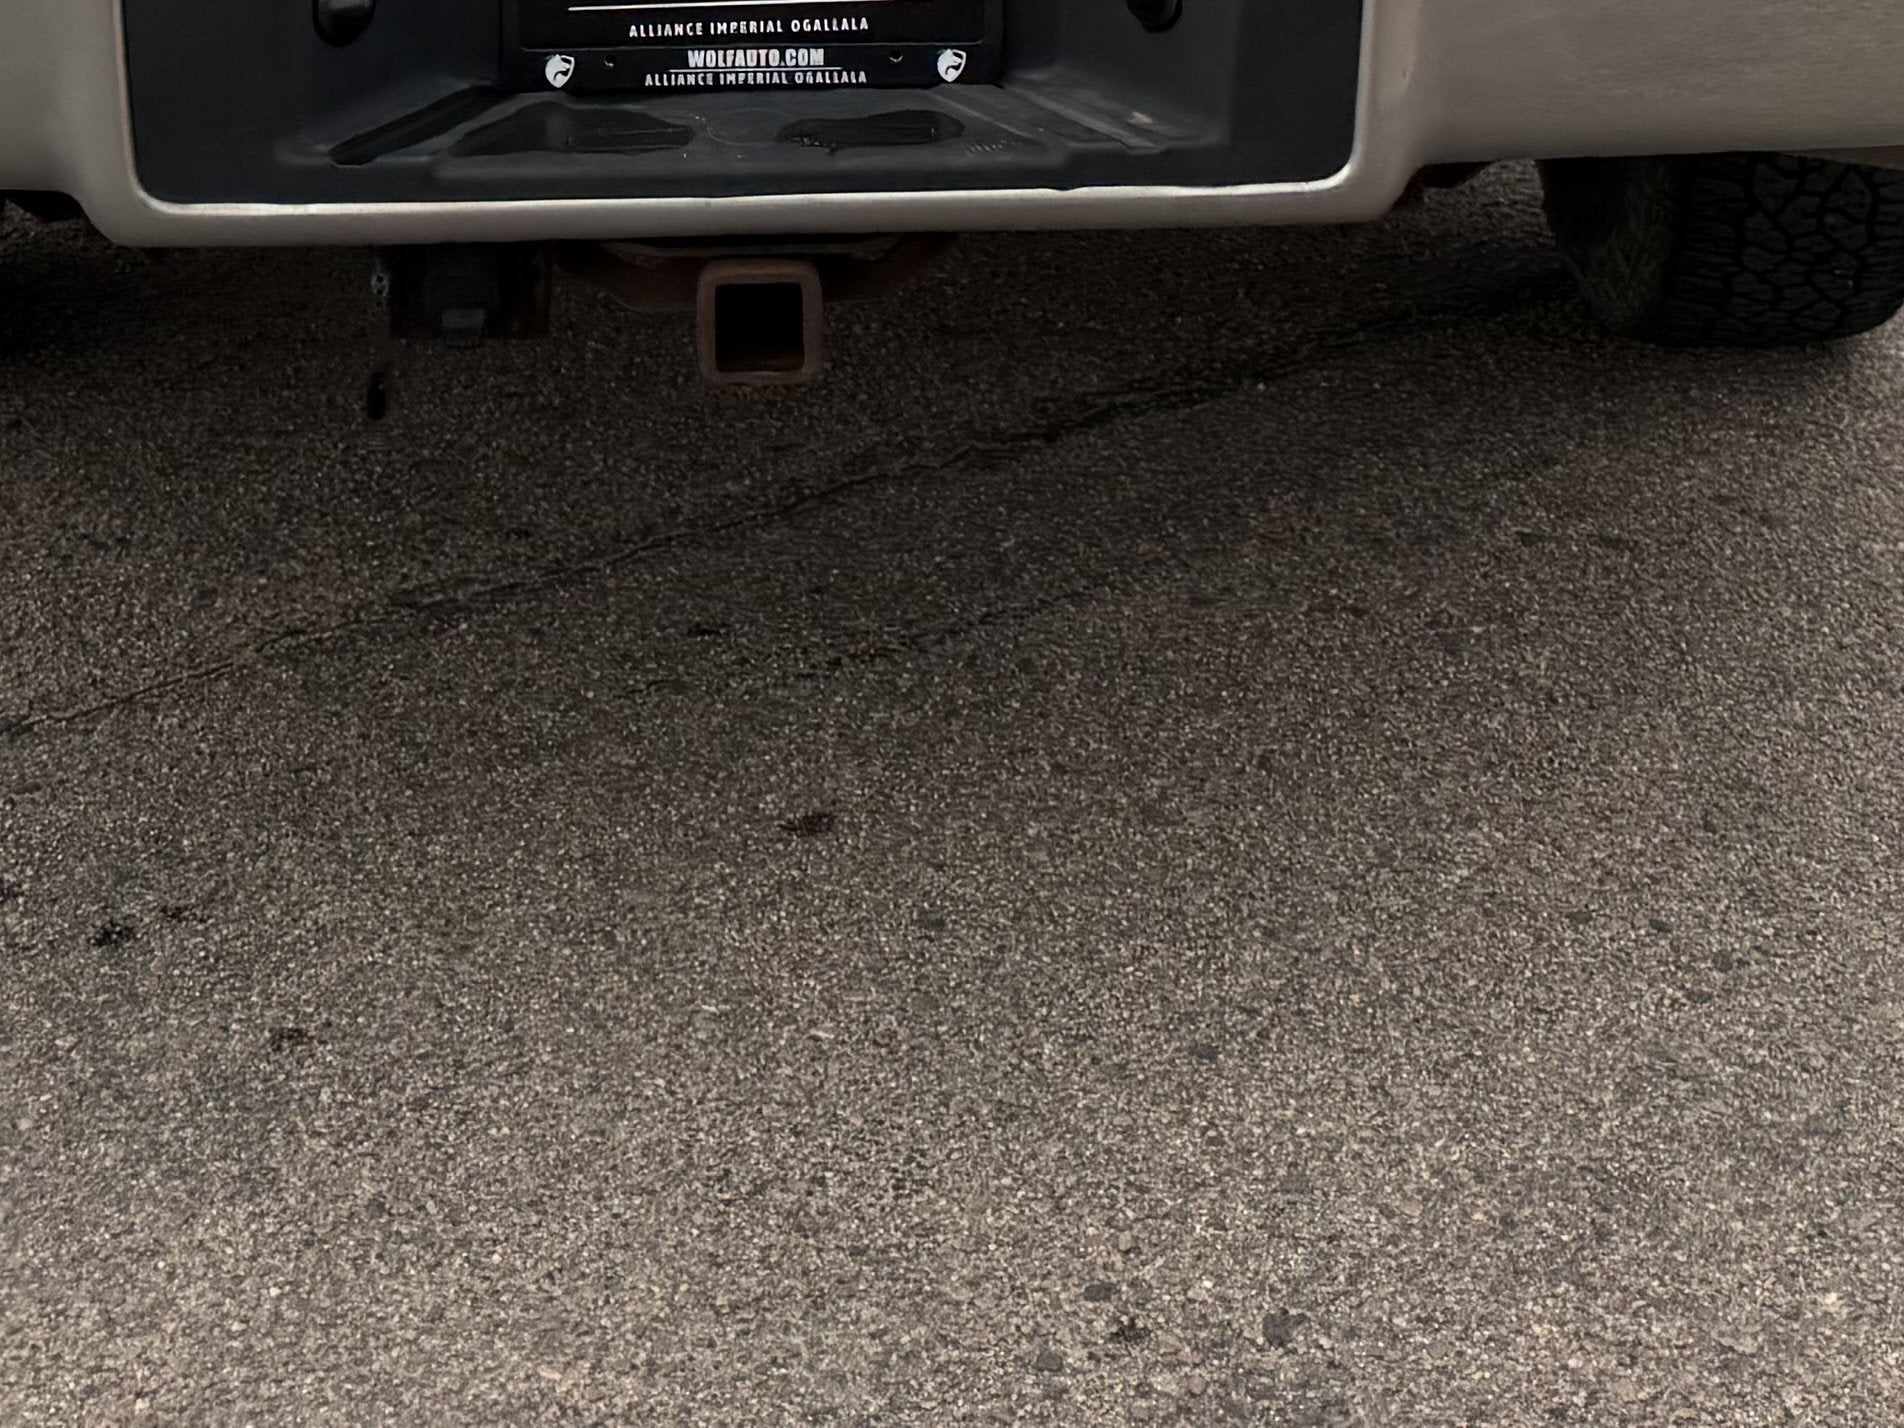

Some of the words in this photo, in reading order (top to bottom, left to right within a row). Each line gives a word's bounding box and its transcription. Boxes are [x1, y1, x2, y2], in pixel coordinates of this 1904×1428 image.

[629, 21, 704, 38] ALLIANCE
[709, 19, 784, 36] IMPERIAL
[790, 16, 870, 33] OGALLALA
[687, 47, 825, 68] WOLFAUTO.COM
[644, 72, 714, 87] ALLIANCE
[719, 71, 789, 85] IMPERIAL
[794, 70, 868, 85] OGALLALA
